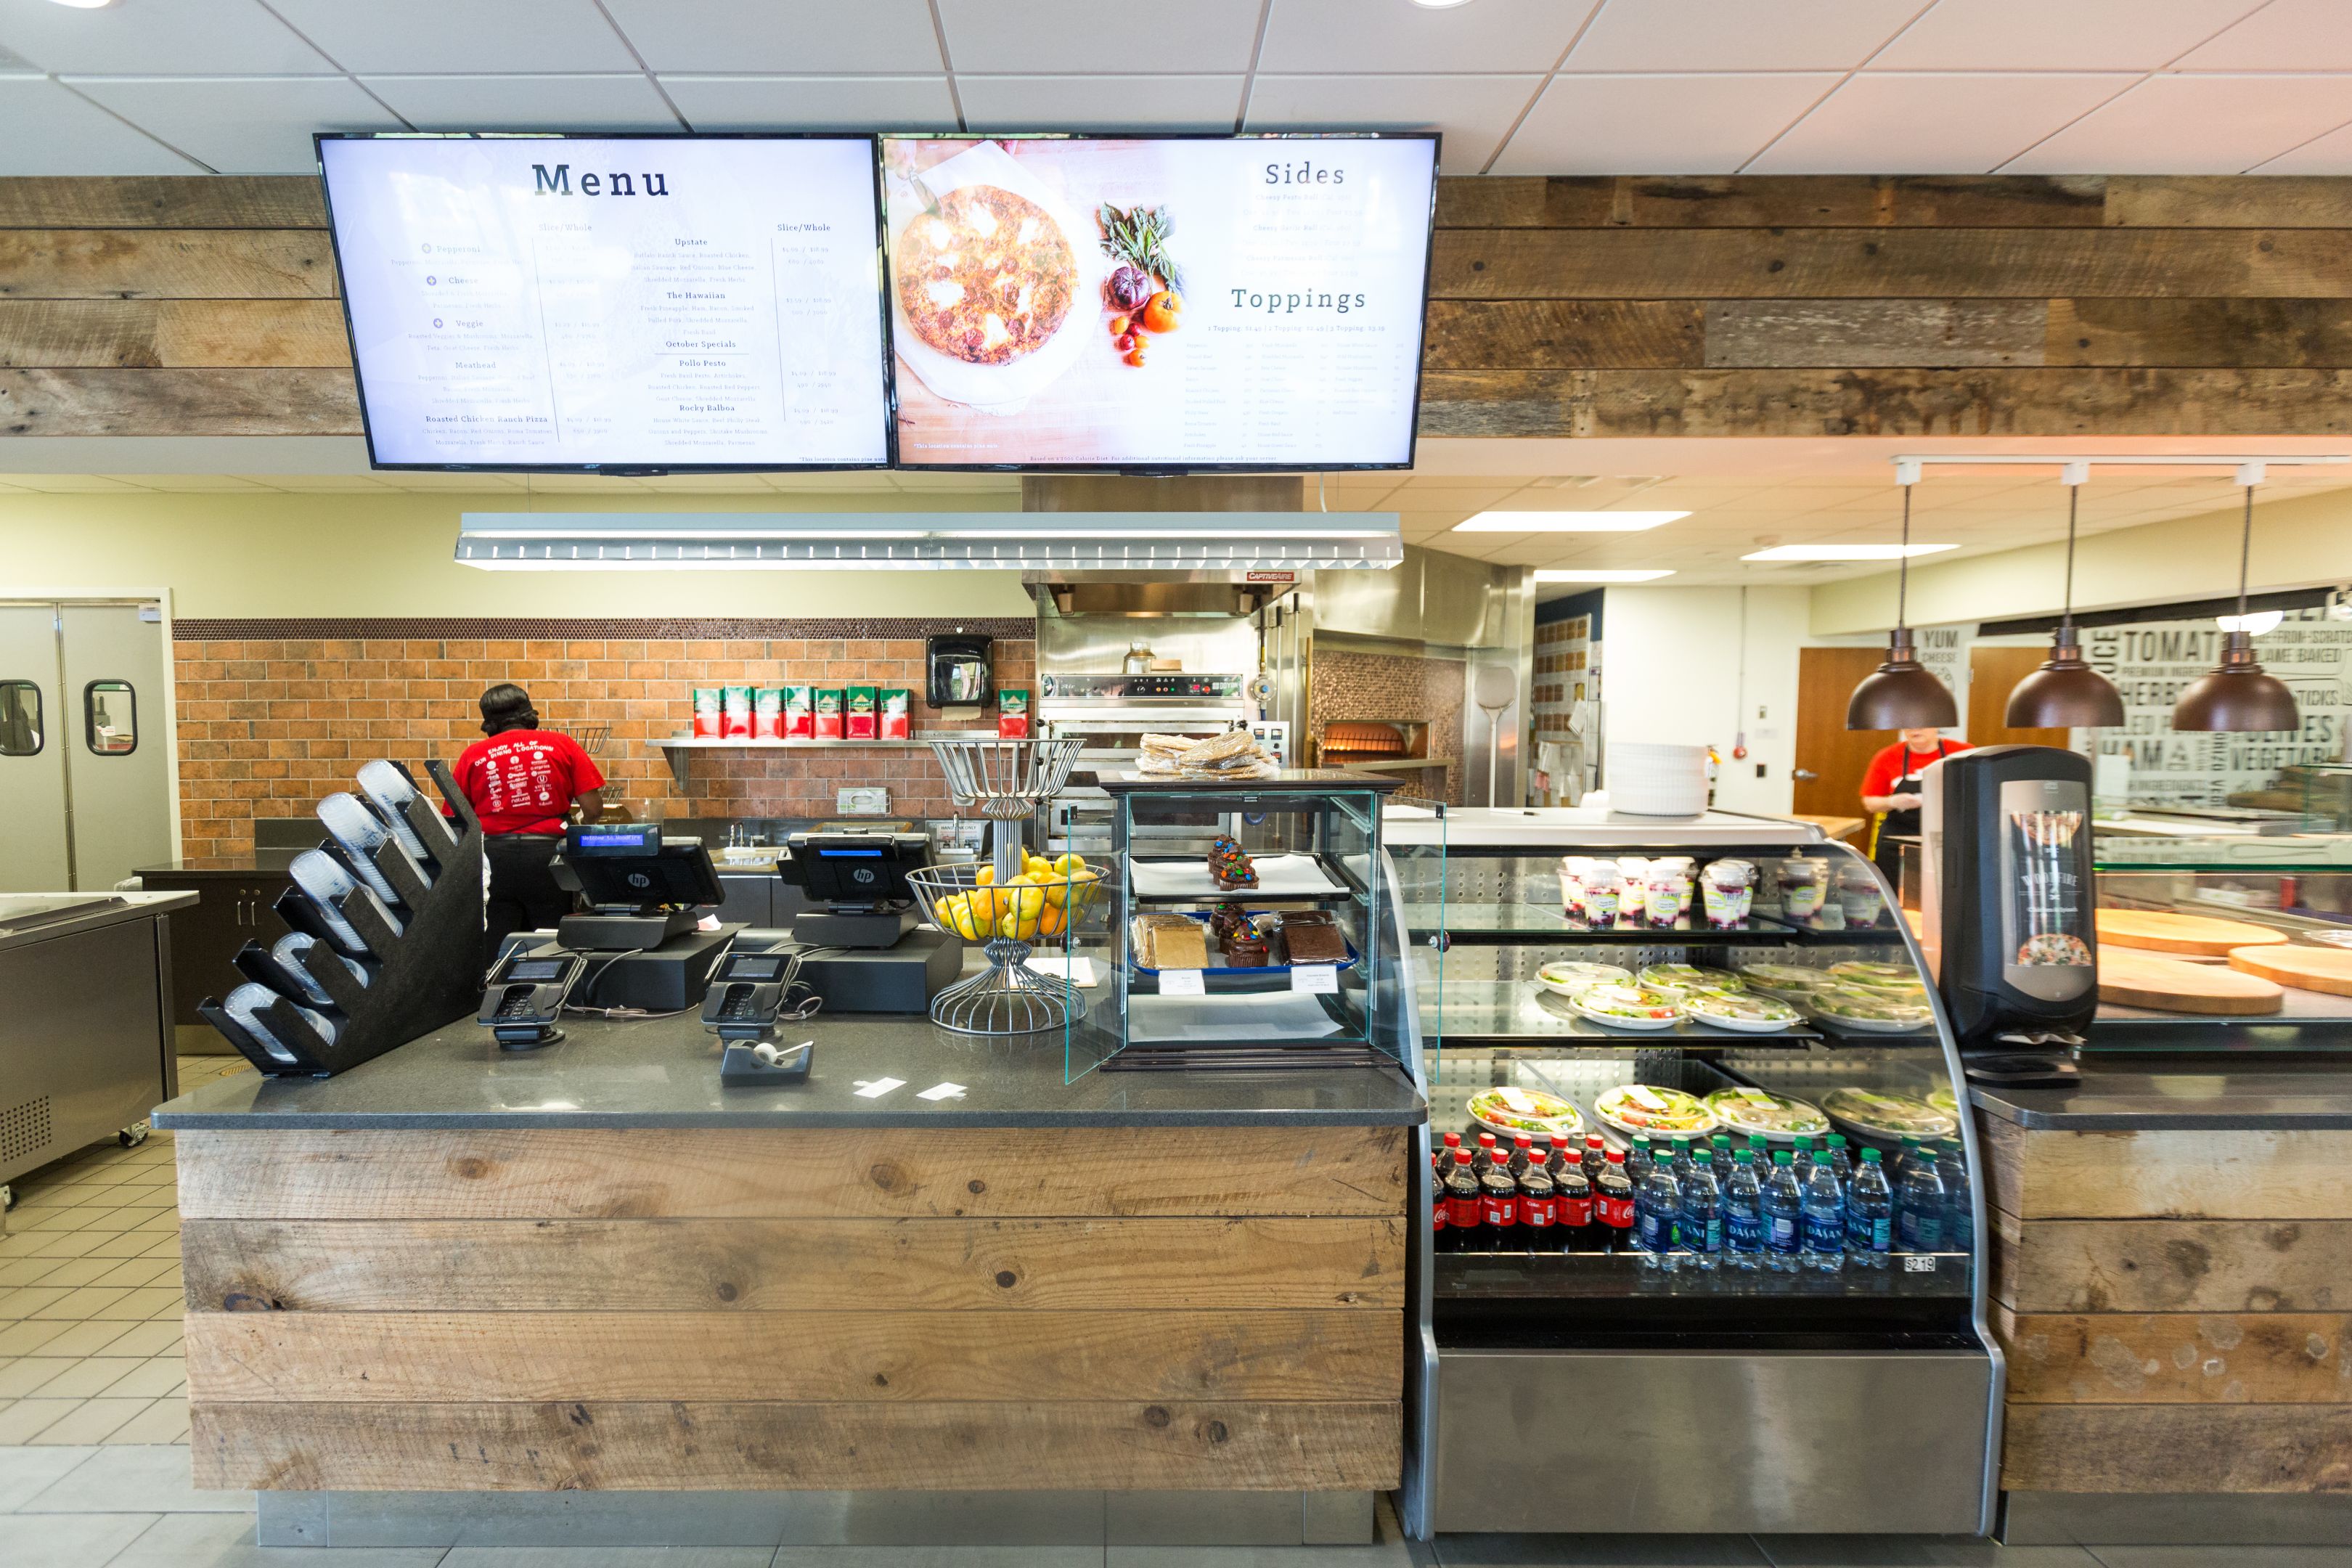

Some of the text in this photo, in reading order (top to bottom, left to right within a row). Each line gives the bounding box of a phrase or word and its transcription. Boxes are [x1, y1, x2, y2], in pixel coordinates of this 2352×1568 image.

[1265, 161, 1345, 184] Sides
[532, 164, 669, 197] Menu
[539, 224, 592, 232] Slice/Whole
[436, 244, 481, 254] Pepperoni
[674, 238, 709, 247] Upstate
[1230, 287, 1366, 314] Toppings
[1924, 630, 1959, 648] YUM
[2124, 630, 2217, 661] TOMAT
[1922, 652, 1957, 663] CHEESE
[487, 744, 508, 755] ENJOY
[474, 757, 487, 767] OUR
[490, 748, 513, 759] DINING
[633, 874, 646, 888] hp
[857, 869, 870, 883] hp
[1728, 1225, 1762, 1240] DASAN
[1807, 1225, 1842, 1240] DASAN
[1906, 1258, 1935, 1270] $2.19
